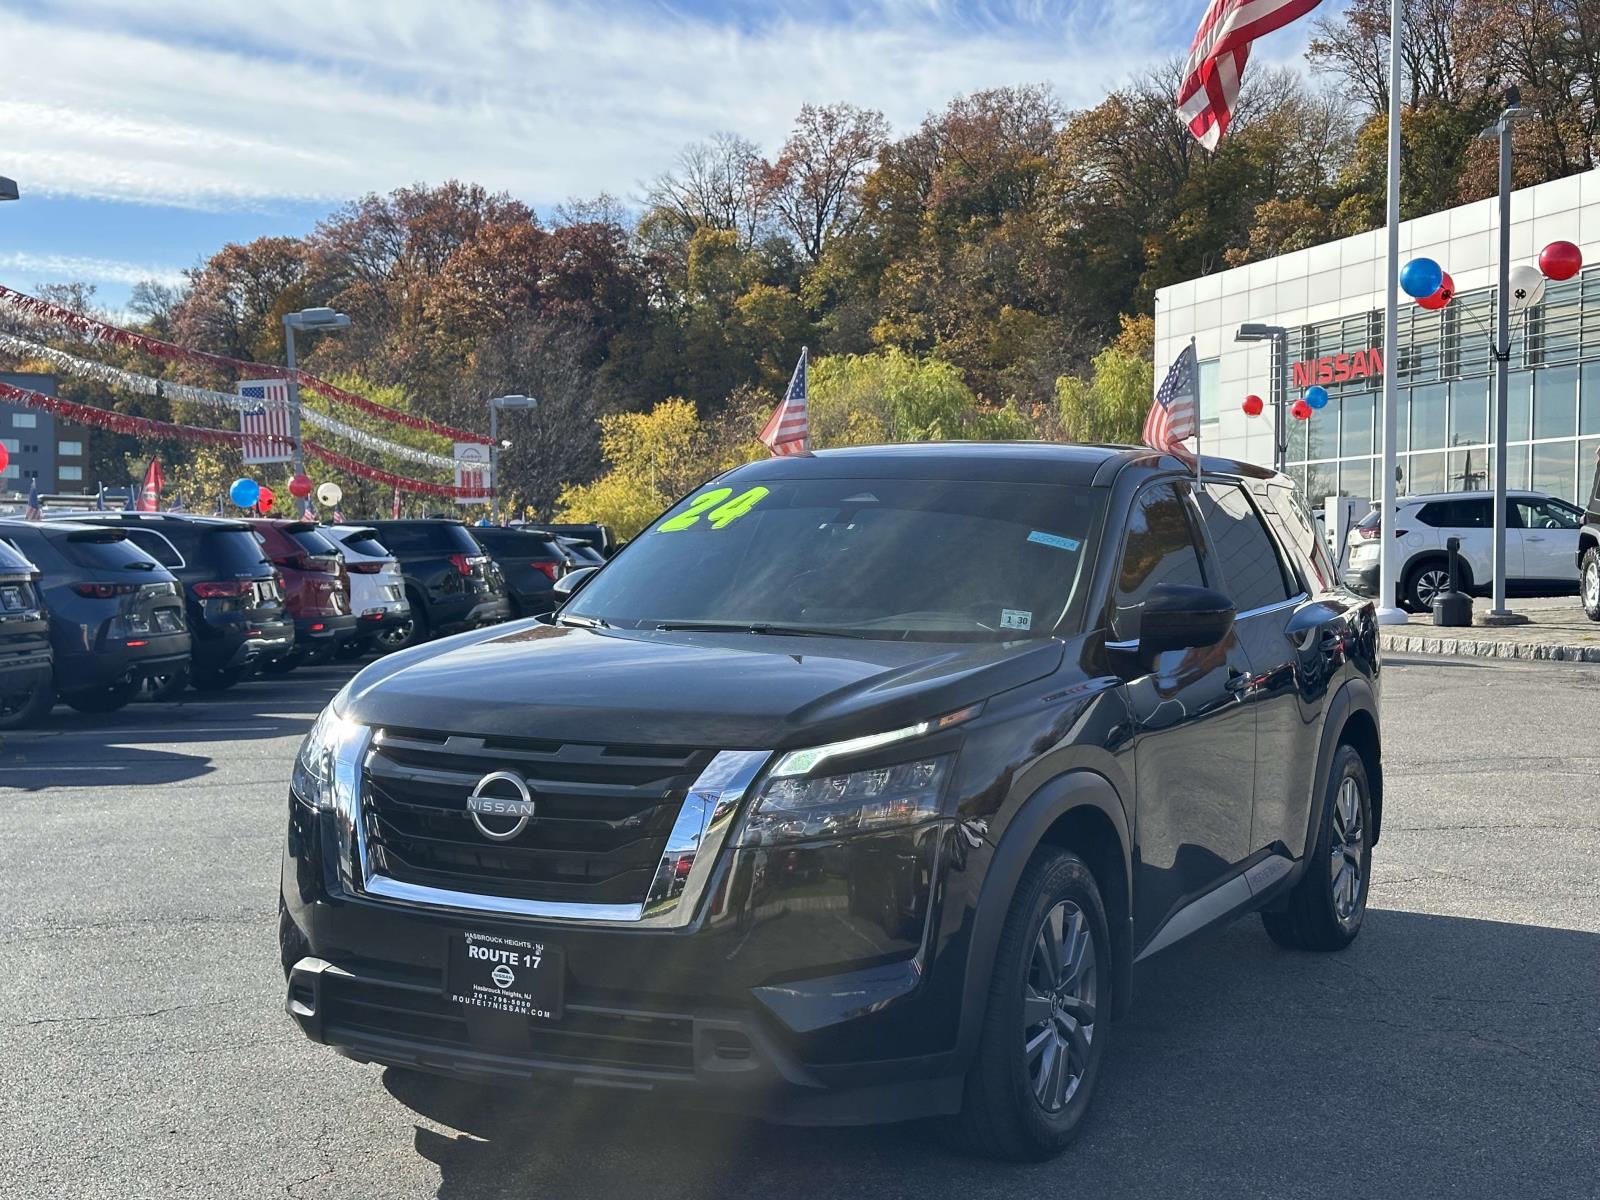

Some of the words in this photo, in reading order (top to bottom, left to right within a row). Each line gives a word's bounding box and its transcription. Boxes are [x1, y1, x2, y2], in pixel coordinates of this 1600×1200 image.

[1292, 347, 1384, 389] NISSAN
[656, 486, 770, 533] 24
[1017, 616, 1028, 625] 30
[467, 799, 532, 815] NISSAN
[464, 931, 503, 944] HASBROUCK
[535, 943, 544, 951] NJ
[468, 945, 519, 966] ROUTE
[523, 954, 541, 969] 17
[493, 972, 513, 980] NISSAN
[472, 983, 501, 994] Hasbrouck
[452, 994, 550, 1018] ROUTE17NISSAN.COM
